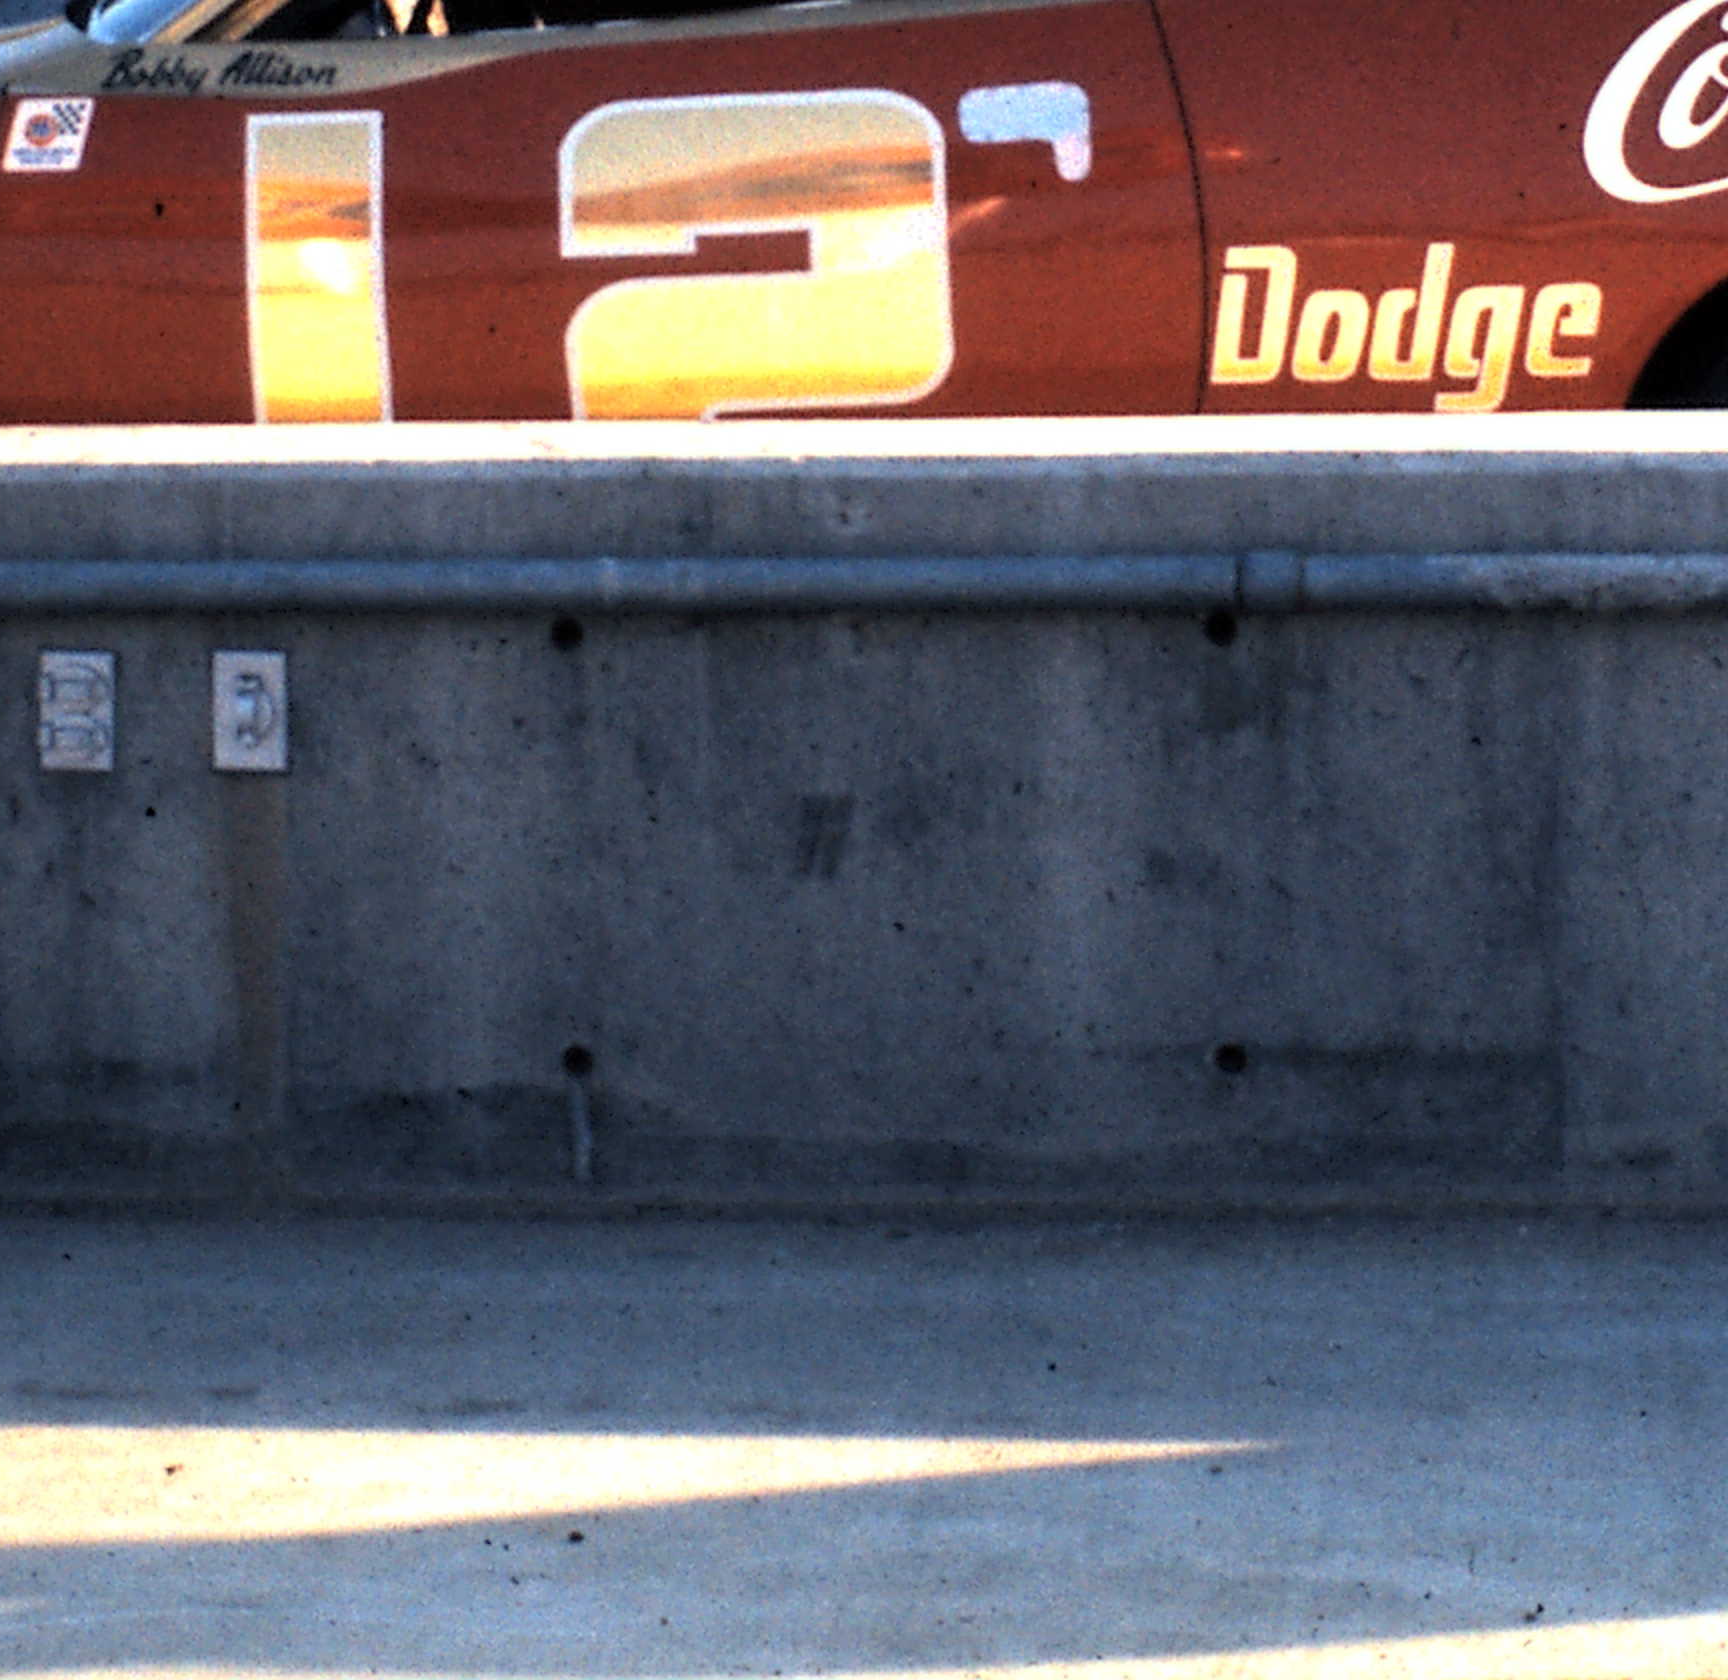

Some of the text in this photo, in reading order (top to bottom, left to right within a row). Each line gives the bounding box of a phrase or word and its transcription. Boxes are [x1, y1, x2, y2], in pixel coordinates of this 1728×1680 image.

[101, 48, 337, 96] Bobby Allison
[246, 88, 955, 423] 12
[1211, 242, 1602, 412] Dodge
